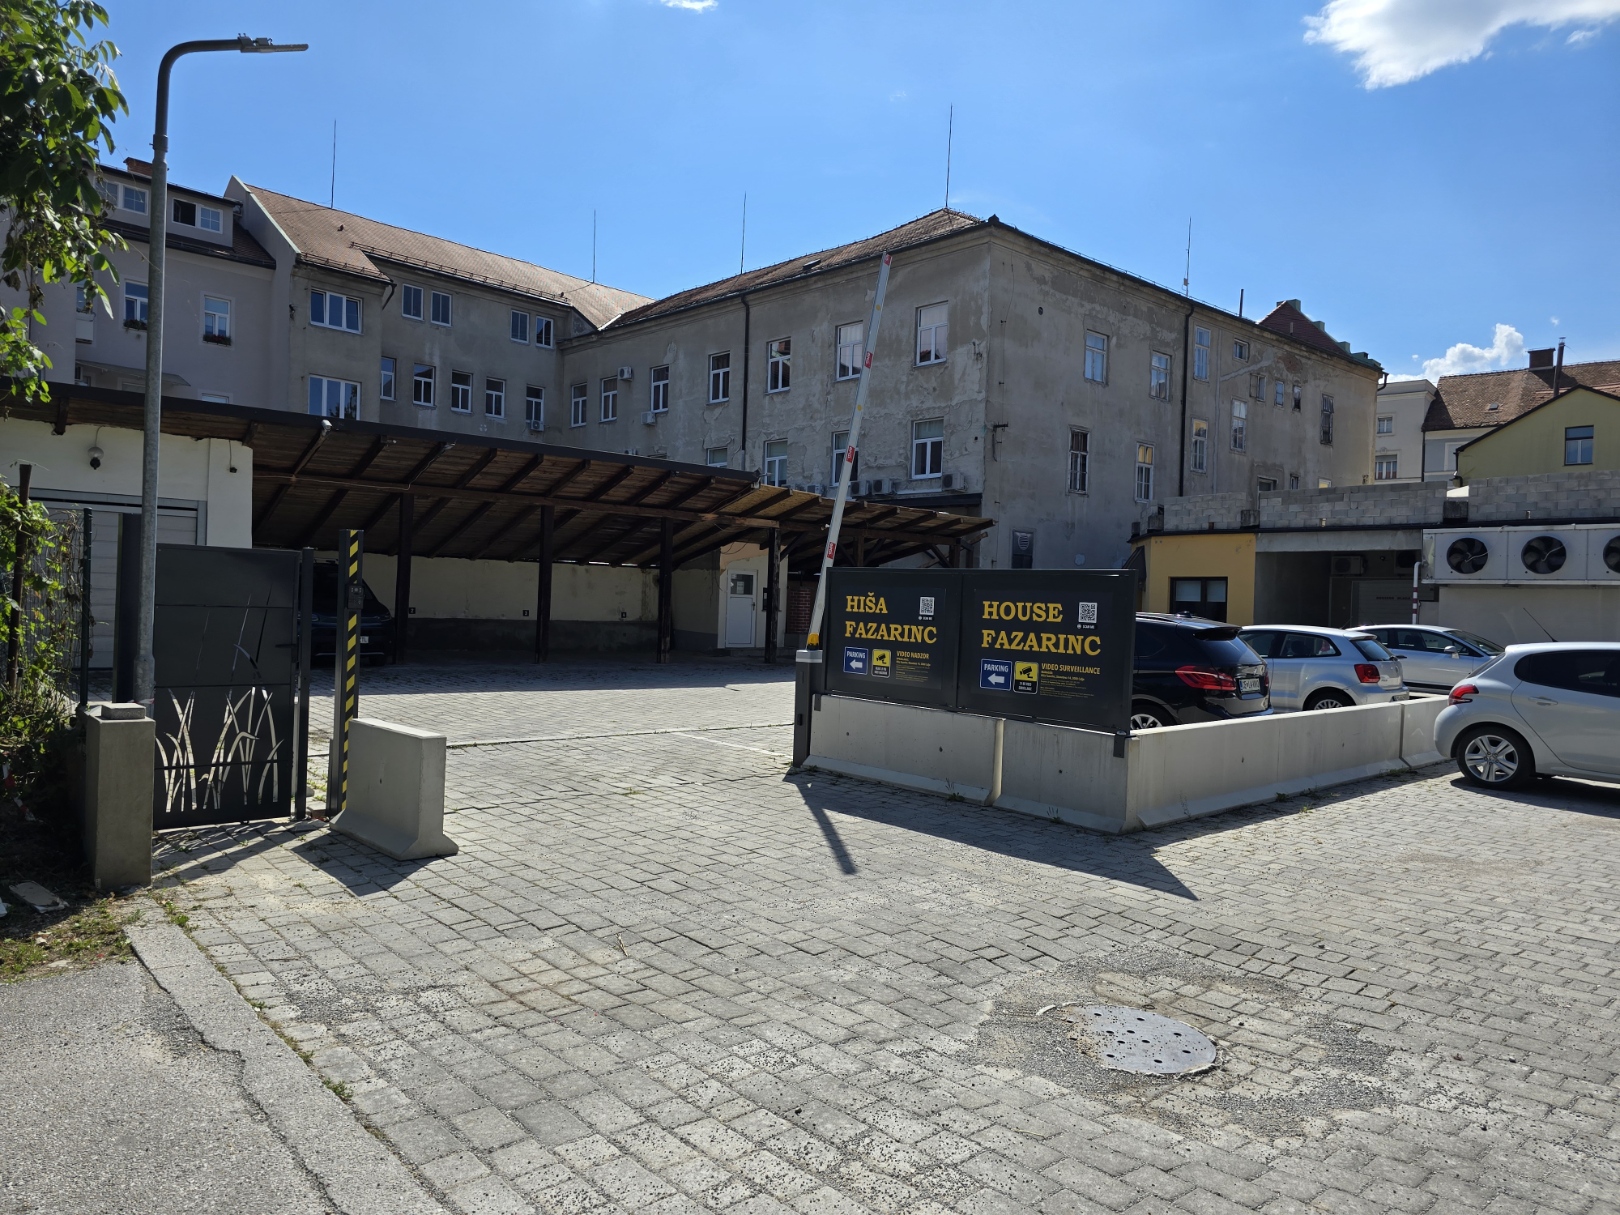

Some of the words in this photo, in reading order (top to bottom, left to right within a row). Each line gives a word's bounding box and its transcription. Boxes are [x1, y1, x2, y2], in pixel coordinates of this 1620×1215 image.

[846, 592, 888, 614] HIŠA
[982, 600, 1062, 622] HOUSE
[845, 620, 937, 644] FAZARINC
[981, 630, 1101, 656] FAZARINC
[846, 650, 866, 659] PARKING
[984, 663, 1009, 673] PARKING
[1059, 664, 1101, 674] SURVEILLANCE
